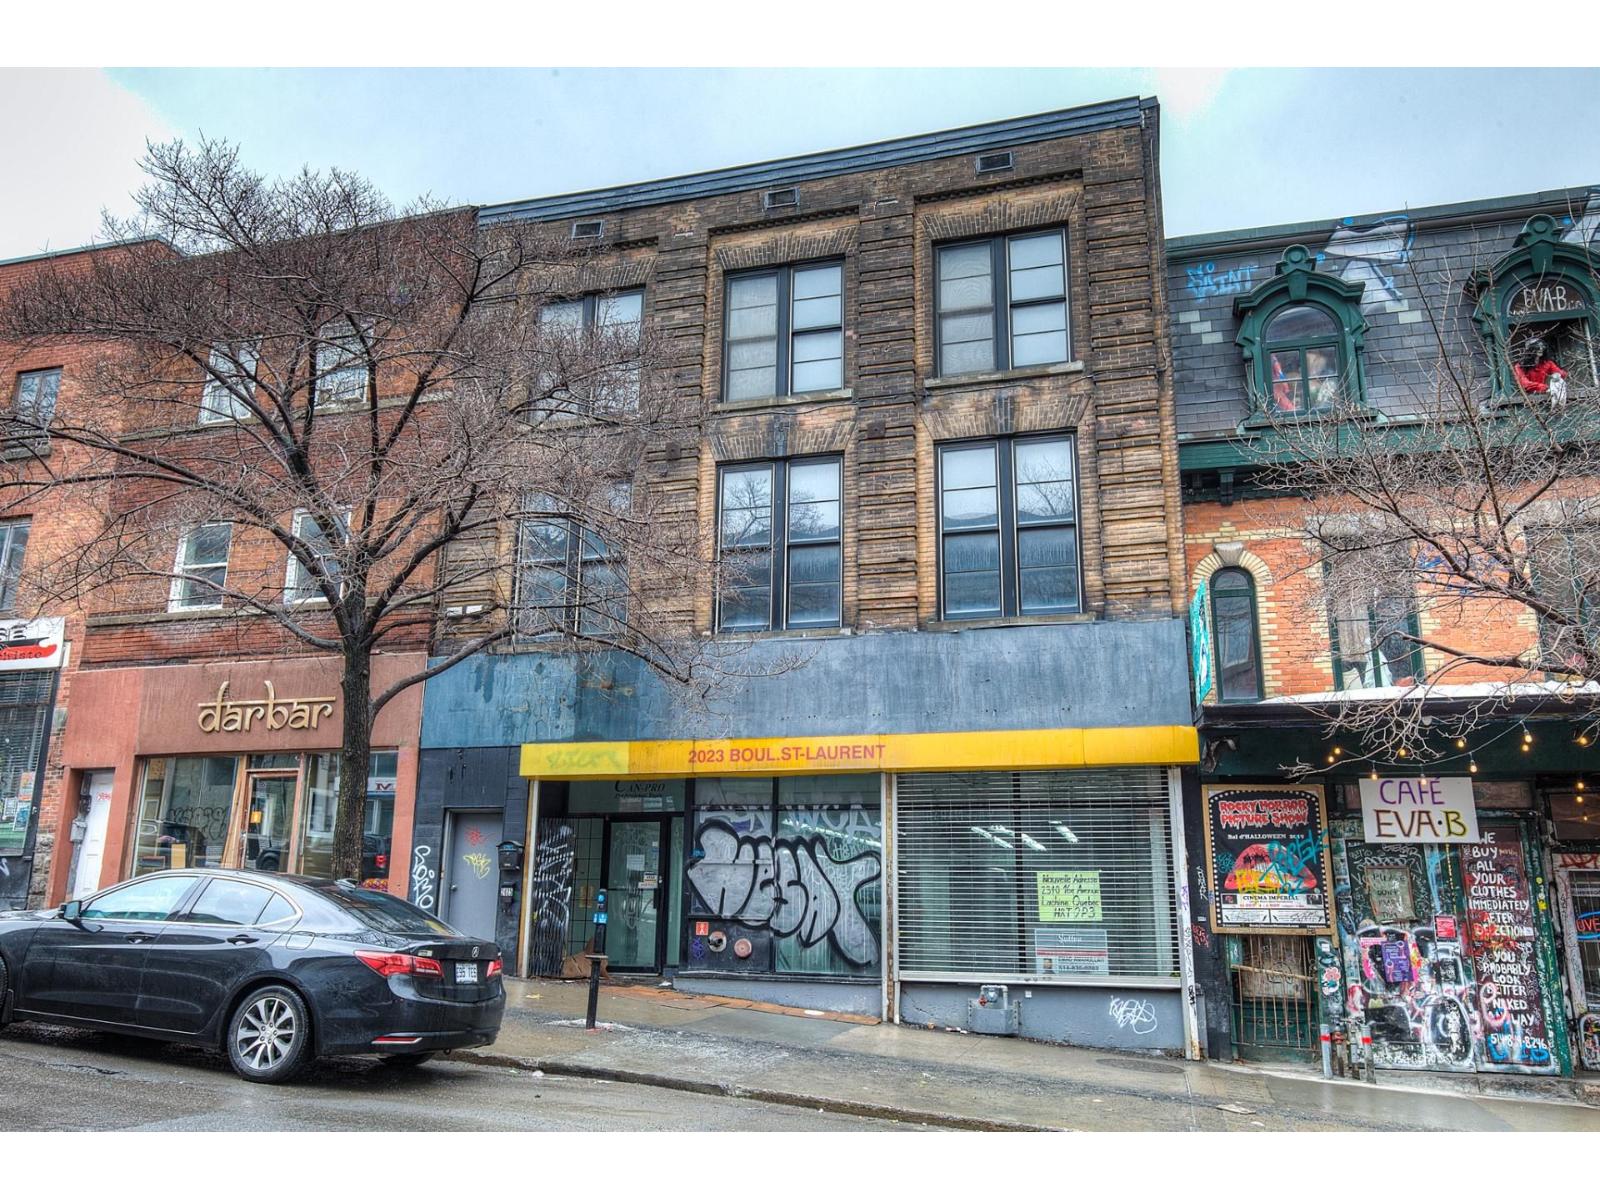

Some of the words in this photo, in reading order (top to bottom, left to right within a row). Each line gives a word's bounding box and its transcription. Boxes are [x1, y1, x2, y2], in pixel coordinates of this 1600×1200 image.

[198, 680, 336, 732] darbar
[688, 750, 725, 764] 2023
[1380, 776, 1445, 805] CAFÉ
[1219, 801, 1257, 815] ROCKY
[1260, 799, 1308, 815] HORROR
[1221, 814, 1269, 829] PICTURE
[1271, 813, 1308, 829] SHOW
[1472, 846, 1498, 859] BUY
[1476, 860, 1496, 871] ALL
[1472, 872, 1506, 885] YOUR
[1470, 886, 1518, 899] CLOTHES
[1468, 899, 1529, 911] IMMEDIATELY
[1493, 951, 1516, 963] YOU
[1493, 974, 1521, 985] LOOK
